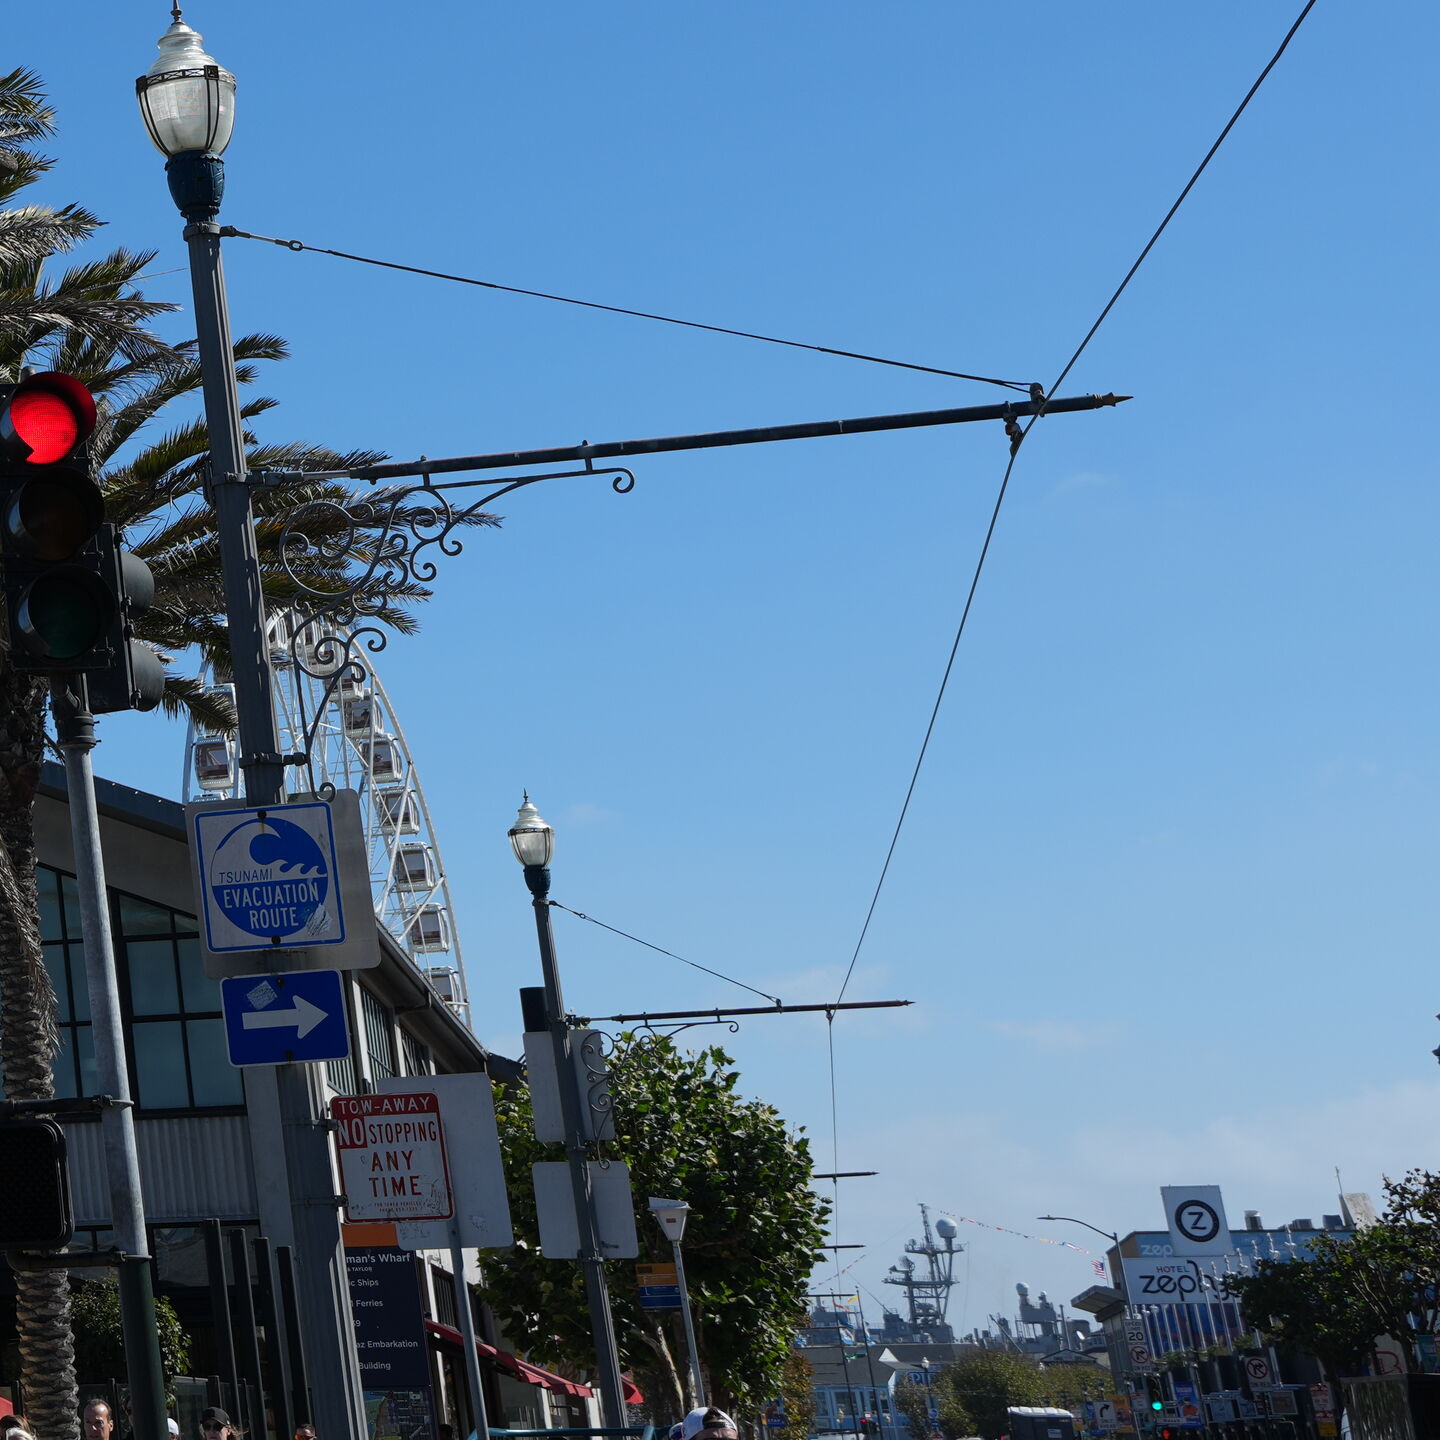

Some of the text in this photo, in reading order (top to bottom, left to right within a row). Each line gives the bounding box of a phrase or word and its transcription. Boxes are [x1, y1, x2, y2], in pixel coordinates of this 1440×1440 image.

[218, 868, 273, 884] TSUNAMI
[223, 881, 320, 909] EVACUATION
[249, 907, 299, 930] ROUTE
[338, 1096, 430, 1115] TOW-AWAY
[338, 1117, 437, 1146] NO STOPPING
[371, 1150, 414, 1172] ANY
[368, 1175, 422, 1198] TIME
[377, 1252, 411, 1263] Wharf
[1155, 1265, 1191, 1274] HOTEL
[357, 1278, 380, 1288] Ships
[355, 1299, 384, 1307] Ferries
[367, 1340, 419, 1348] Embarkation
[1128, 1331, 1144, 1341] 20
